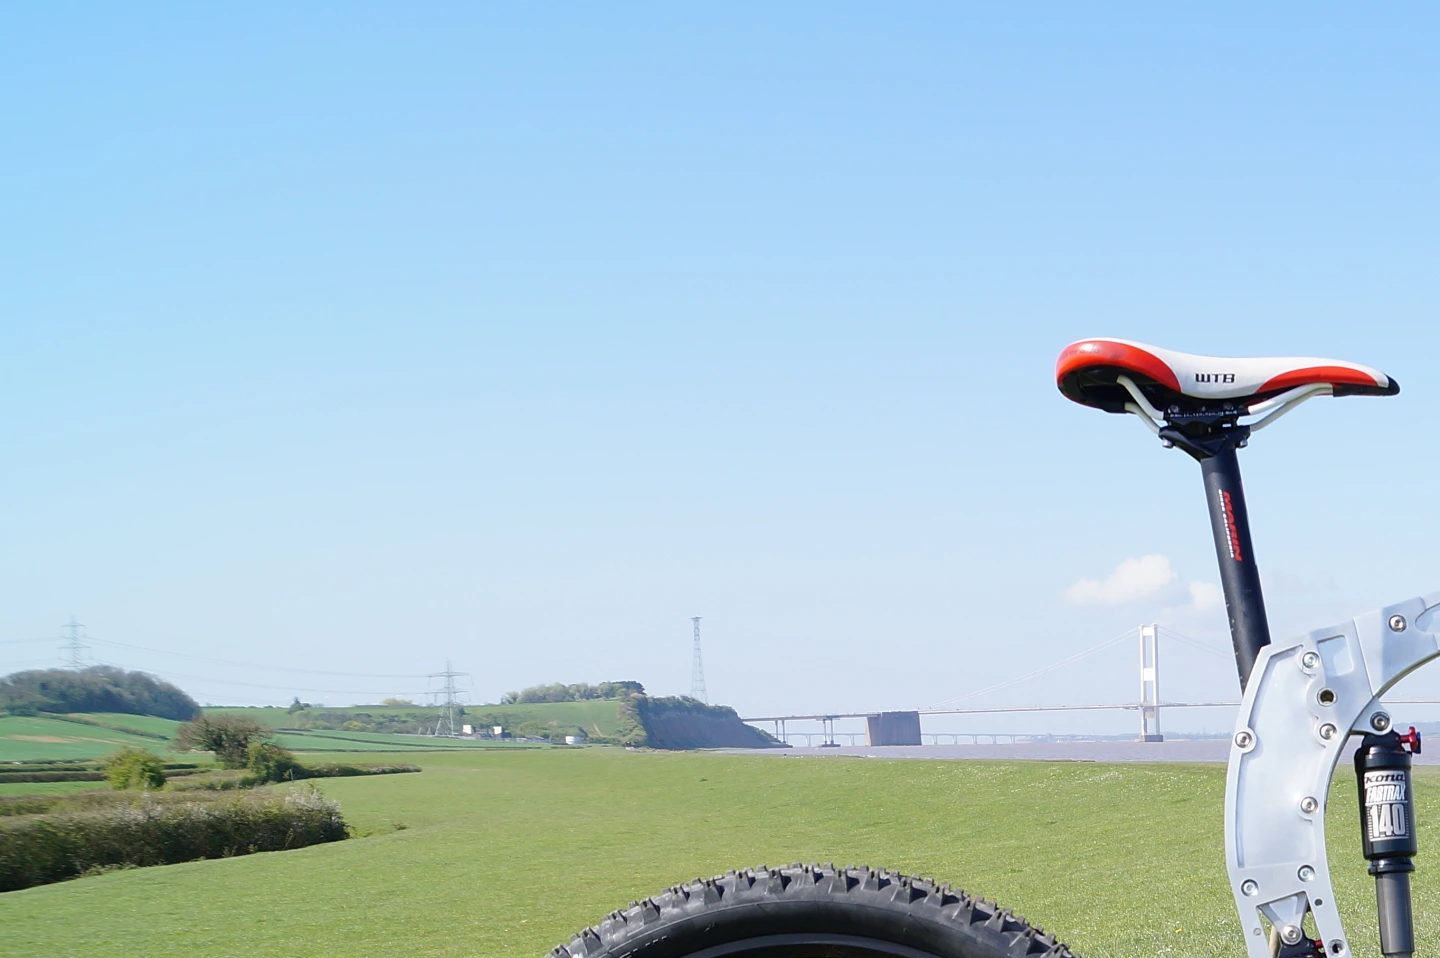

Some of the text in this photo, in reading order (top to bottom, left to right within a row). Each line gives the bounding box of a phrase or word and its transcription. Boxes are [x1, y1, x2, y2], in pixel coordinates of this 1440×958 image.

[1195, 373, 1236, 384] WTB
[1223, 491, 1243, 561] MARIN
[1366, 784, 1406, 803] FASTRAX
[1370, 804, 1406, 838] 140
